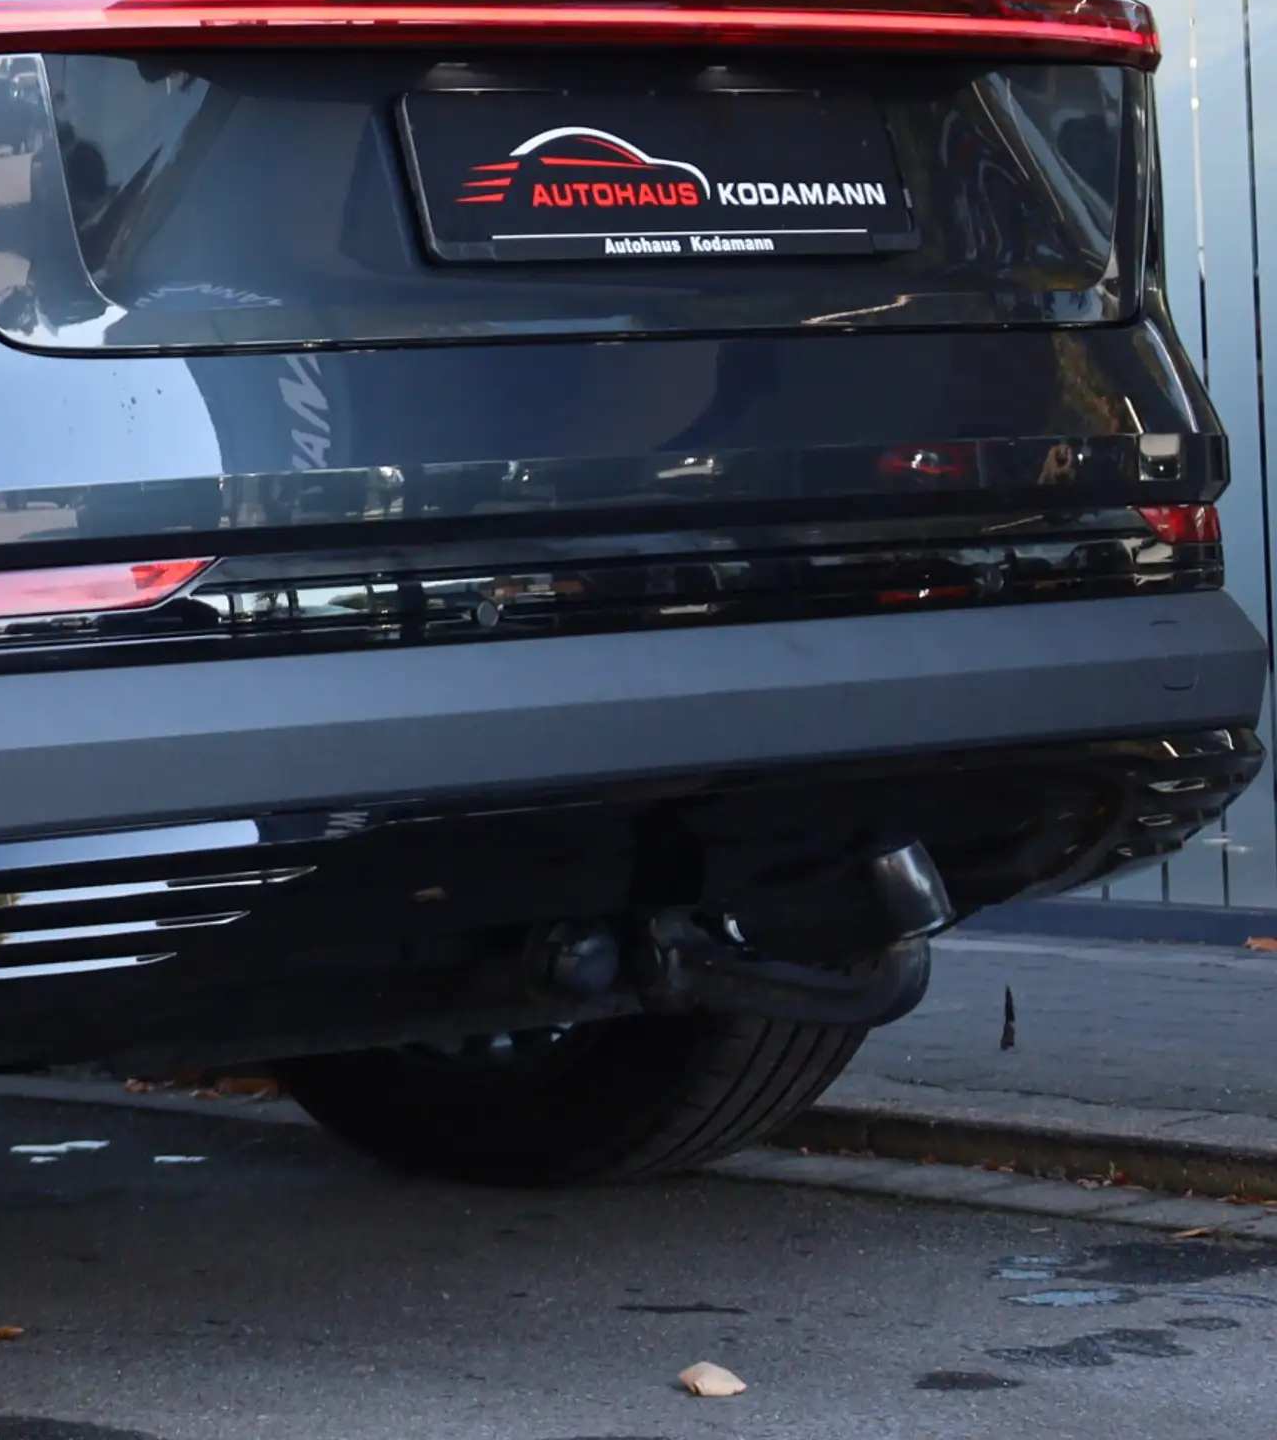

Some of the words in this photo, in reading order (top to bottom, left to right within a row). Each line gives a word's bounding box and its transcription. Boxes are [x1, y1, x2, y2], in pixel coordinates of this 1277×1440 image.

[532, 183, 699, 207] AUTOHAUS
[718, 183, 887, 205] KODAMANN
[605, 238, 681, 254] Autohaus
[691, 235, 774, 251] Kodamann
